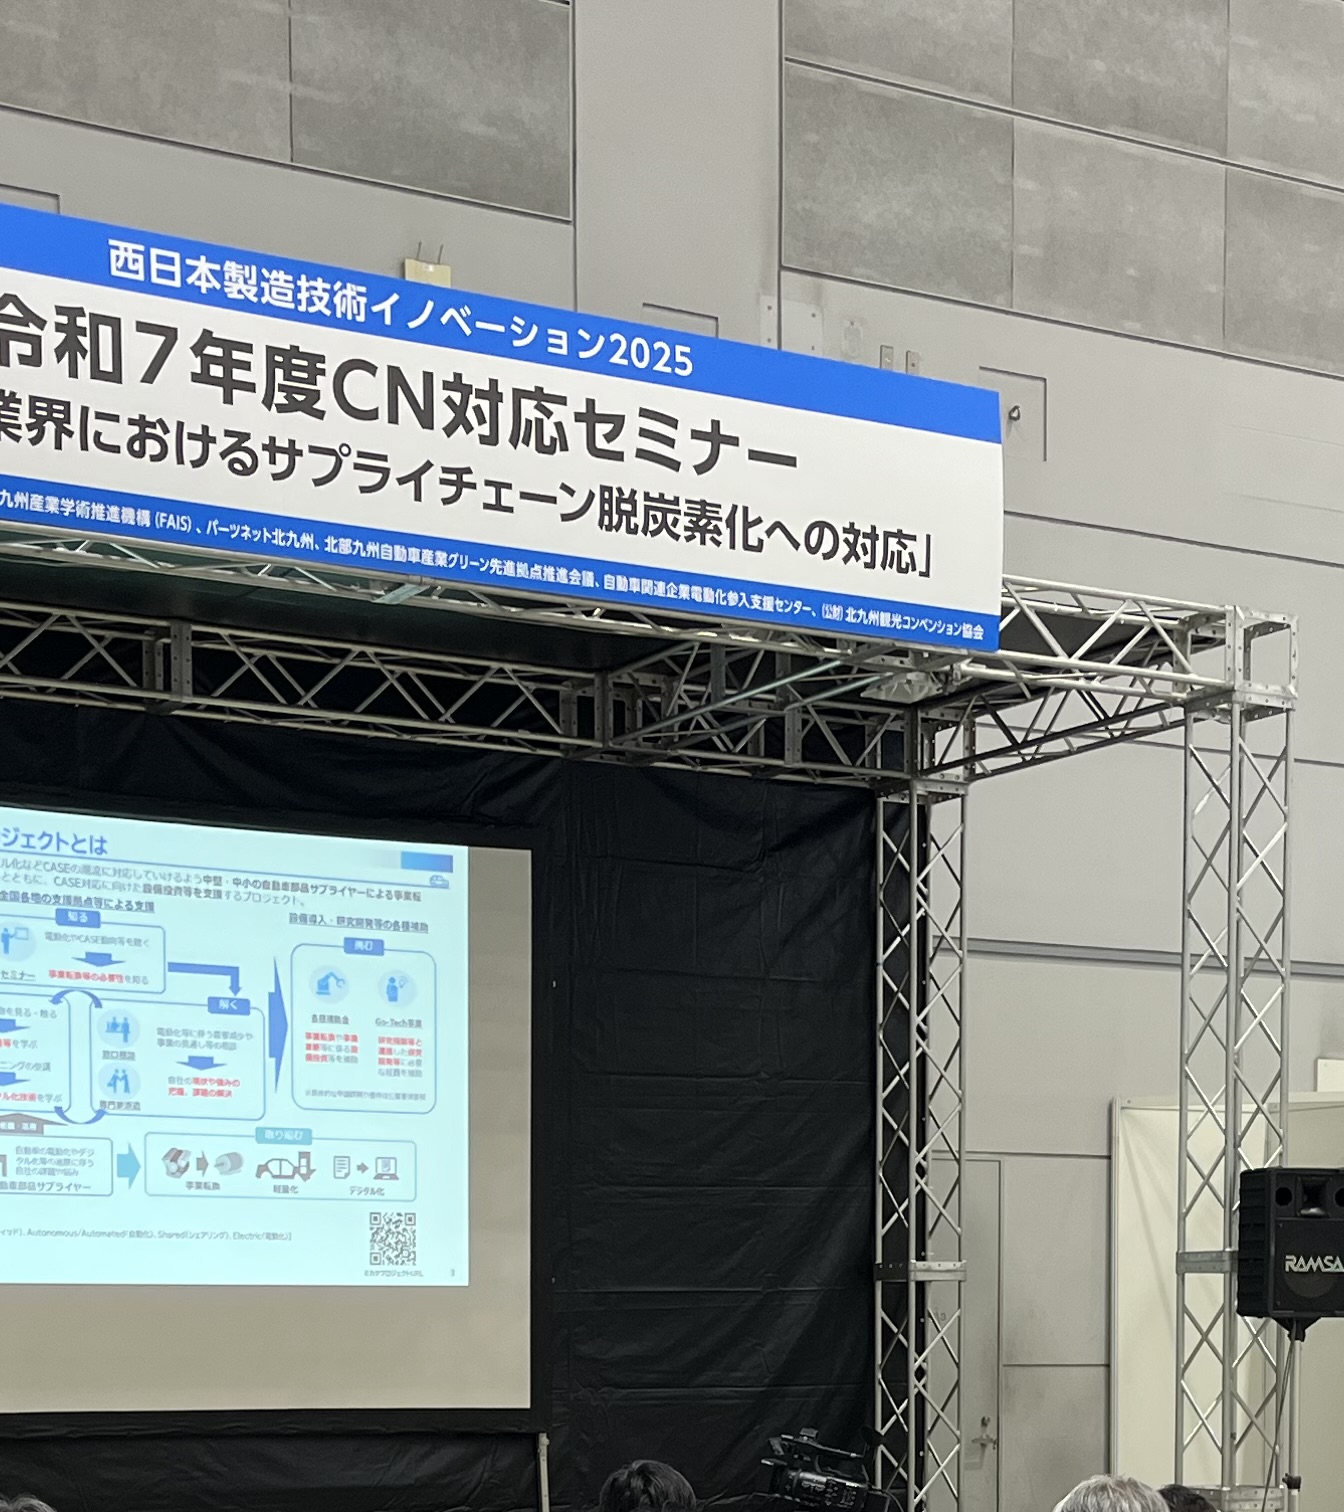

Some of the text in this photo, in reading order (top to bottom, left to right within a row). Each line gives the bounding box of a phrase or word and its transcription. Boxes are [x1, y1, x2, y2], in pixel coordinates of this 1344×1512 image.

[108, 239, 694, 377] 西日本製造技術イノベーション2025
[1285, 1255, 1344, 1273] RAMSA
